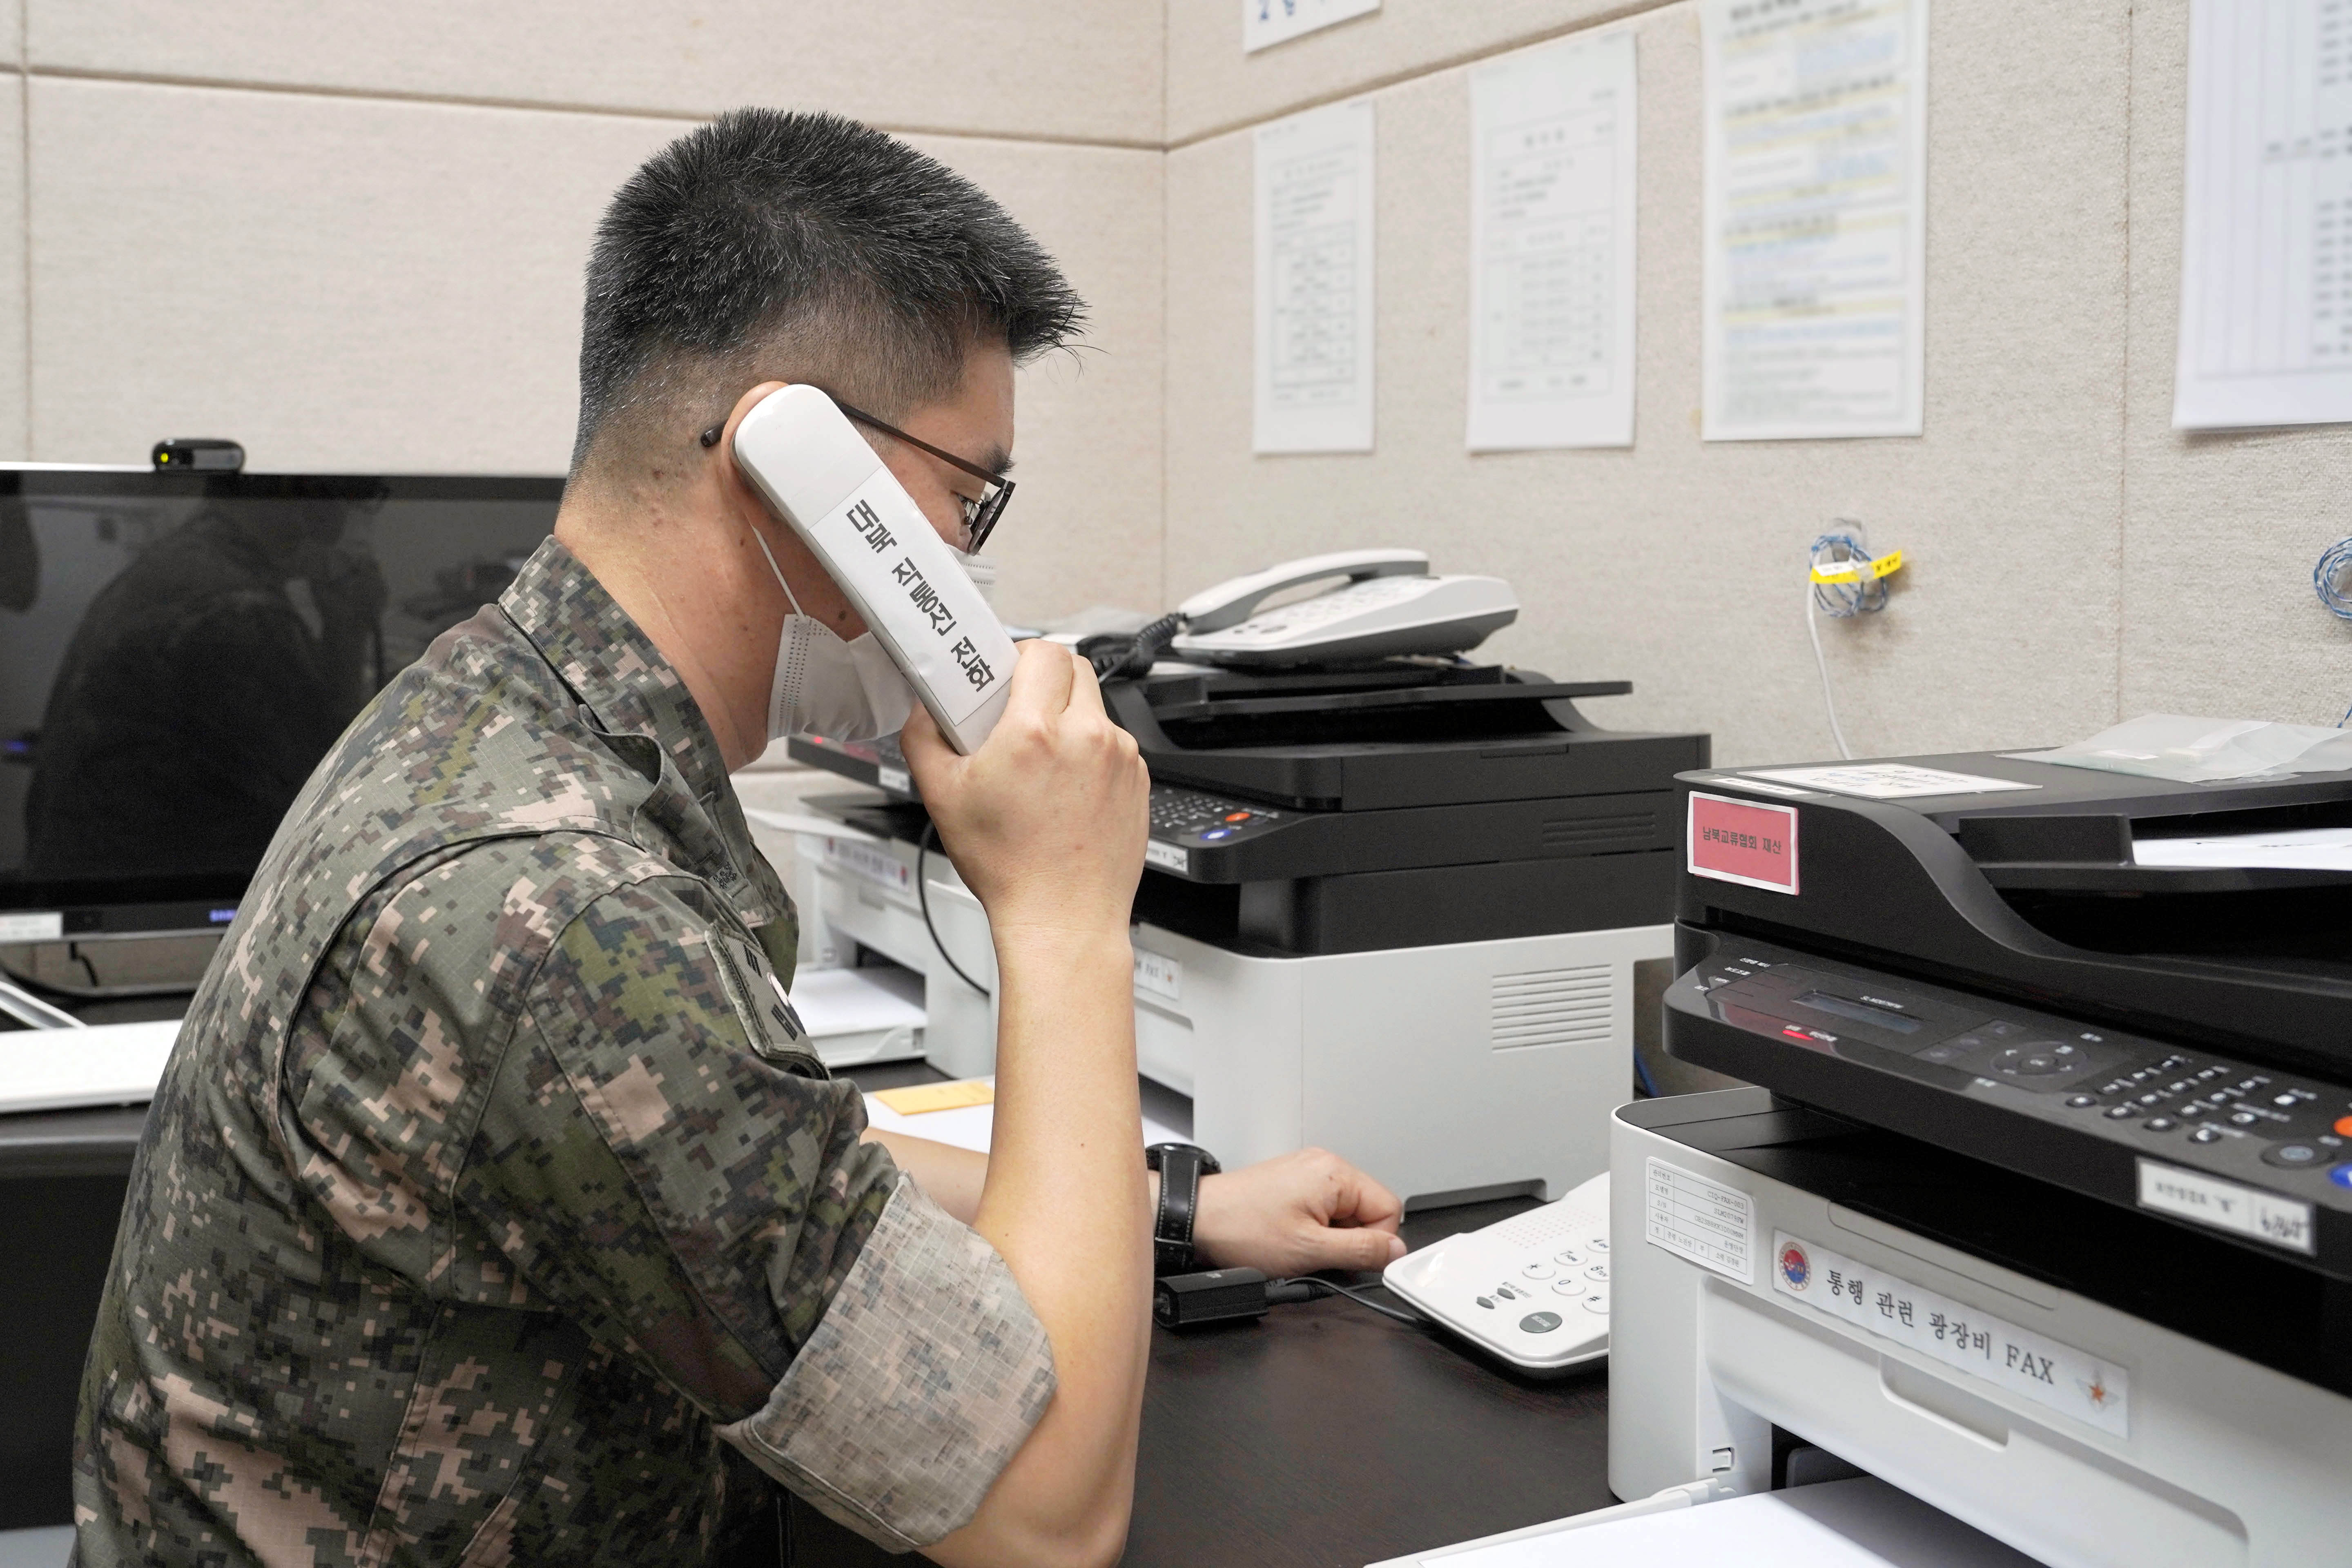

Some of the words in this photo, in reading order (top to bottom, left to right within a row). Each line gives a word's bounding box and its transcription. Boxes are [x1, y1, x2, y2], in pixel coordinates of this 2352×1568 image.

[846, 499, 897, 554] 대북
[892, 557, 957, 637] 직통선
[950, 635, 996, 693] 전화
[1703, 826, 1757, 850] 남북교류협회
[1763, 837, 1781, 854] 재산
[1827, 1270, 1863, 1305] 통행
[1876, 1292, 1914, 1327] 관련
[1928, 1312, 1990, 1360] 광장비
[2006, 1344, 2053, 1385] FAX
